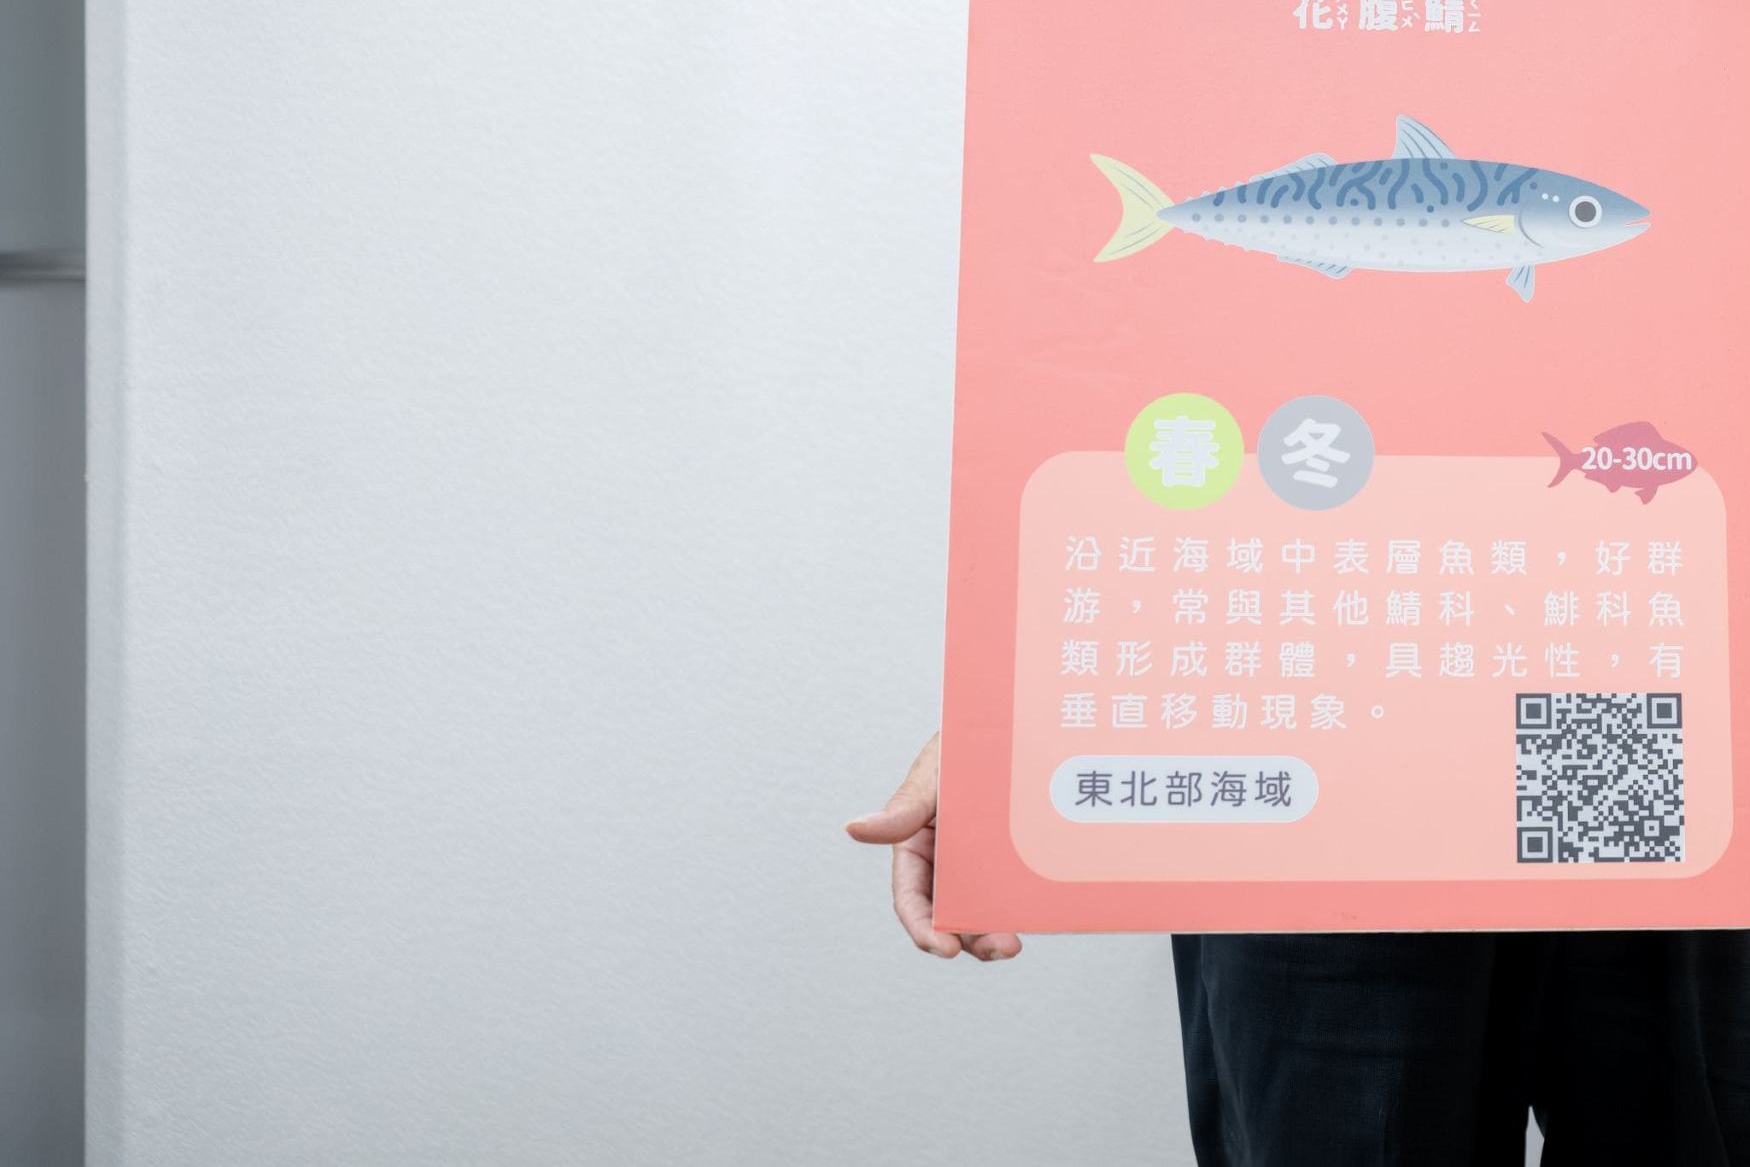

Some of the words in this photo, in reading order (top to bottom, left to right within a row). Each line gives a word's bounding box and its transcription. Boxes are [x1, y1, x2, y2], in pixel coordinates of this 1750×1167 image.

[1148, 415, 1220, 488] 春
[1281, 417, 1351, 489] 冬
[1582, 446, 1692, 471] 20-30cm
[1065, 535, 1683, 577] 沿近海域中表層魚類，好群
[1060, 638, 1684, 679] 類形成群體，具趨光性，有
[1060, 692, 1385, 731] 垂直移動現象。
[1075, 770, 1292, 808] 東北部海域
